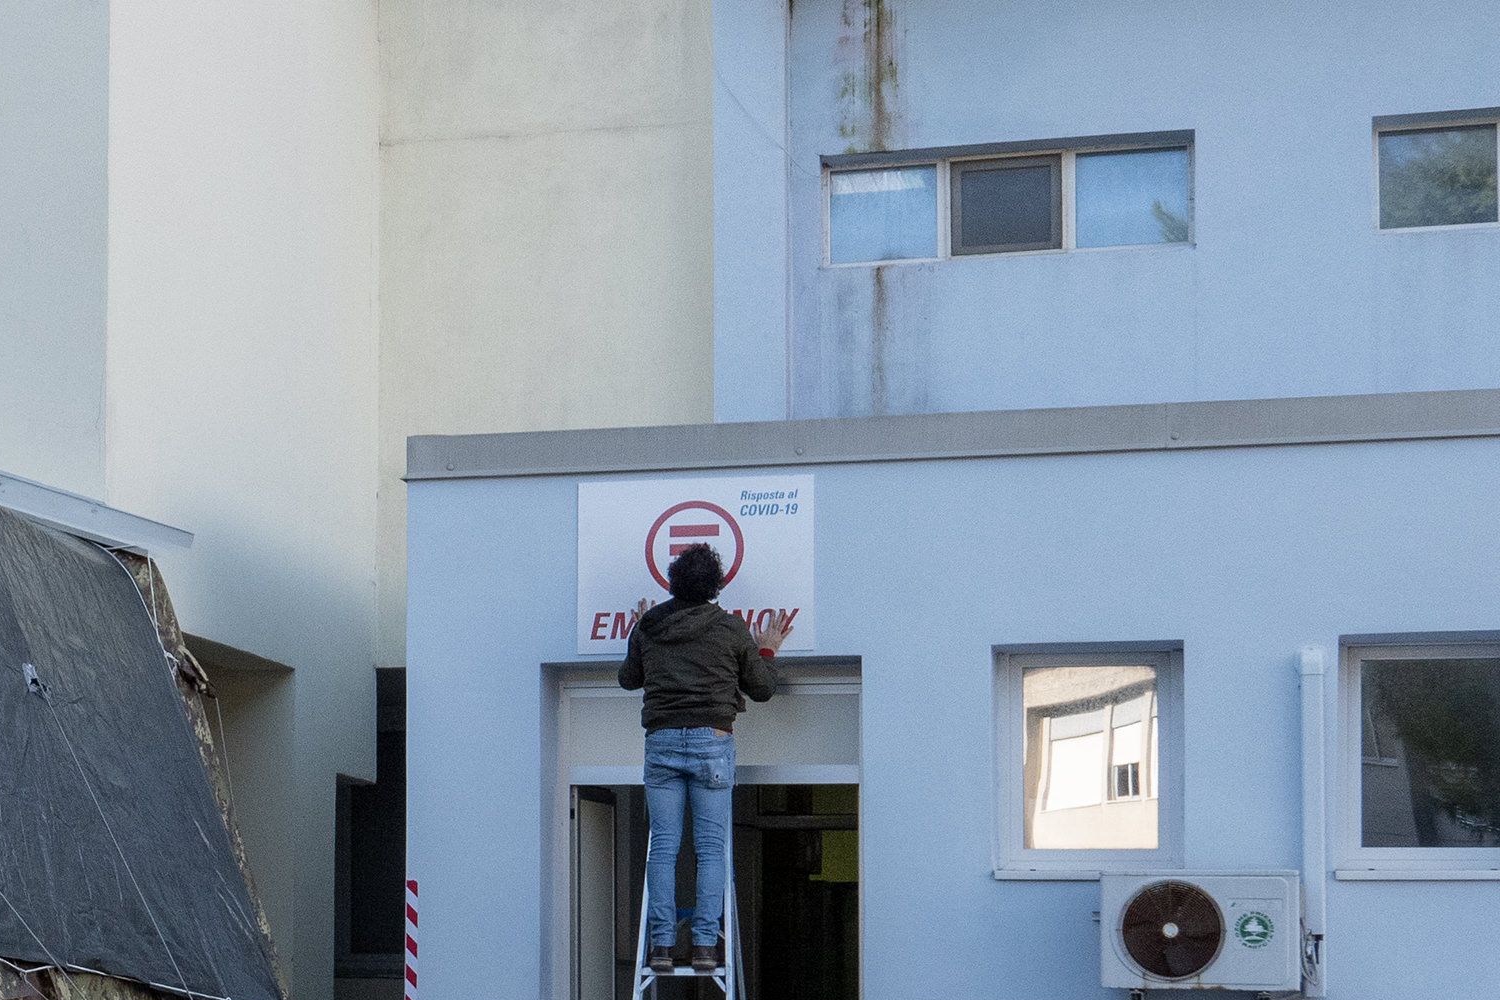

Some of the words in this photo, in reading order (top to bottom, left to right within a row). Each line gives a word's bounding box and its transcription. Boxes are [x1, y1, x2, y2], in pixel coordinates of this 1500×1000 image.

[740, 490, 784, 502] Risposta
[787, 489, 798, 499] al
[740, 503, 798, 516] COVID-19
